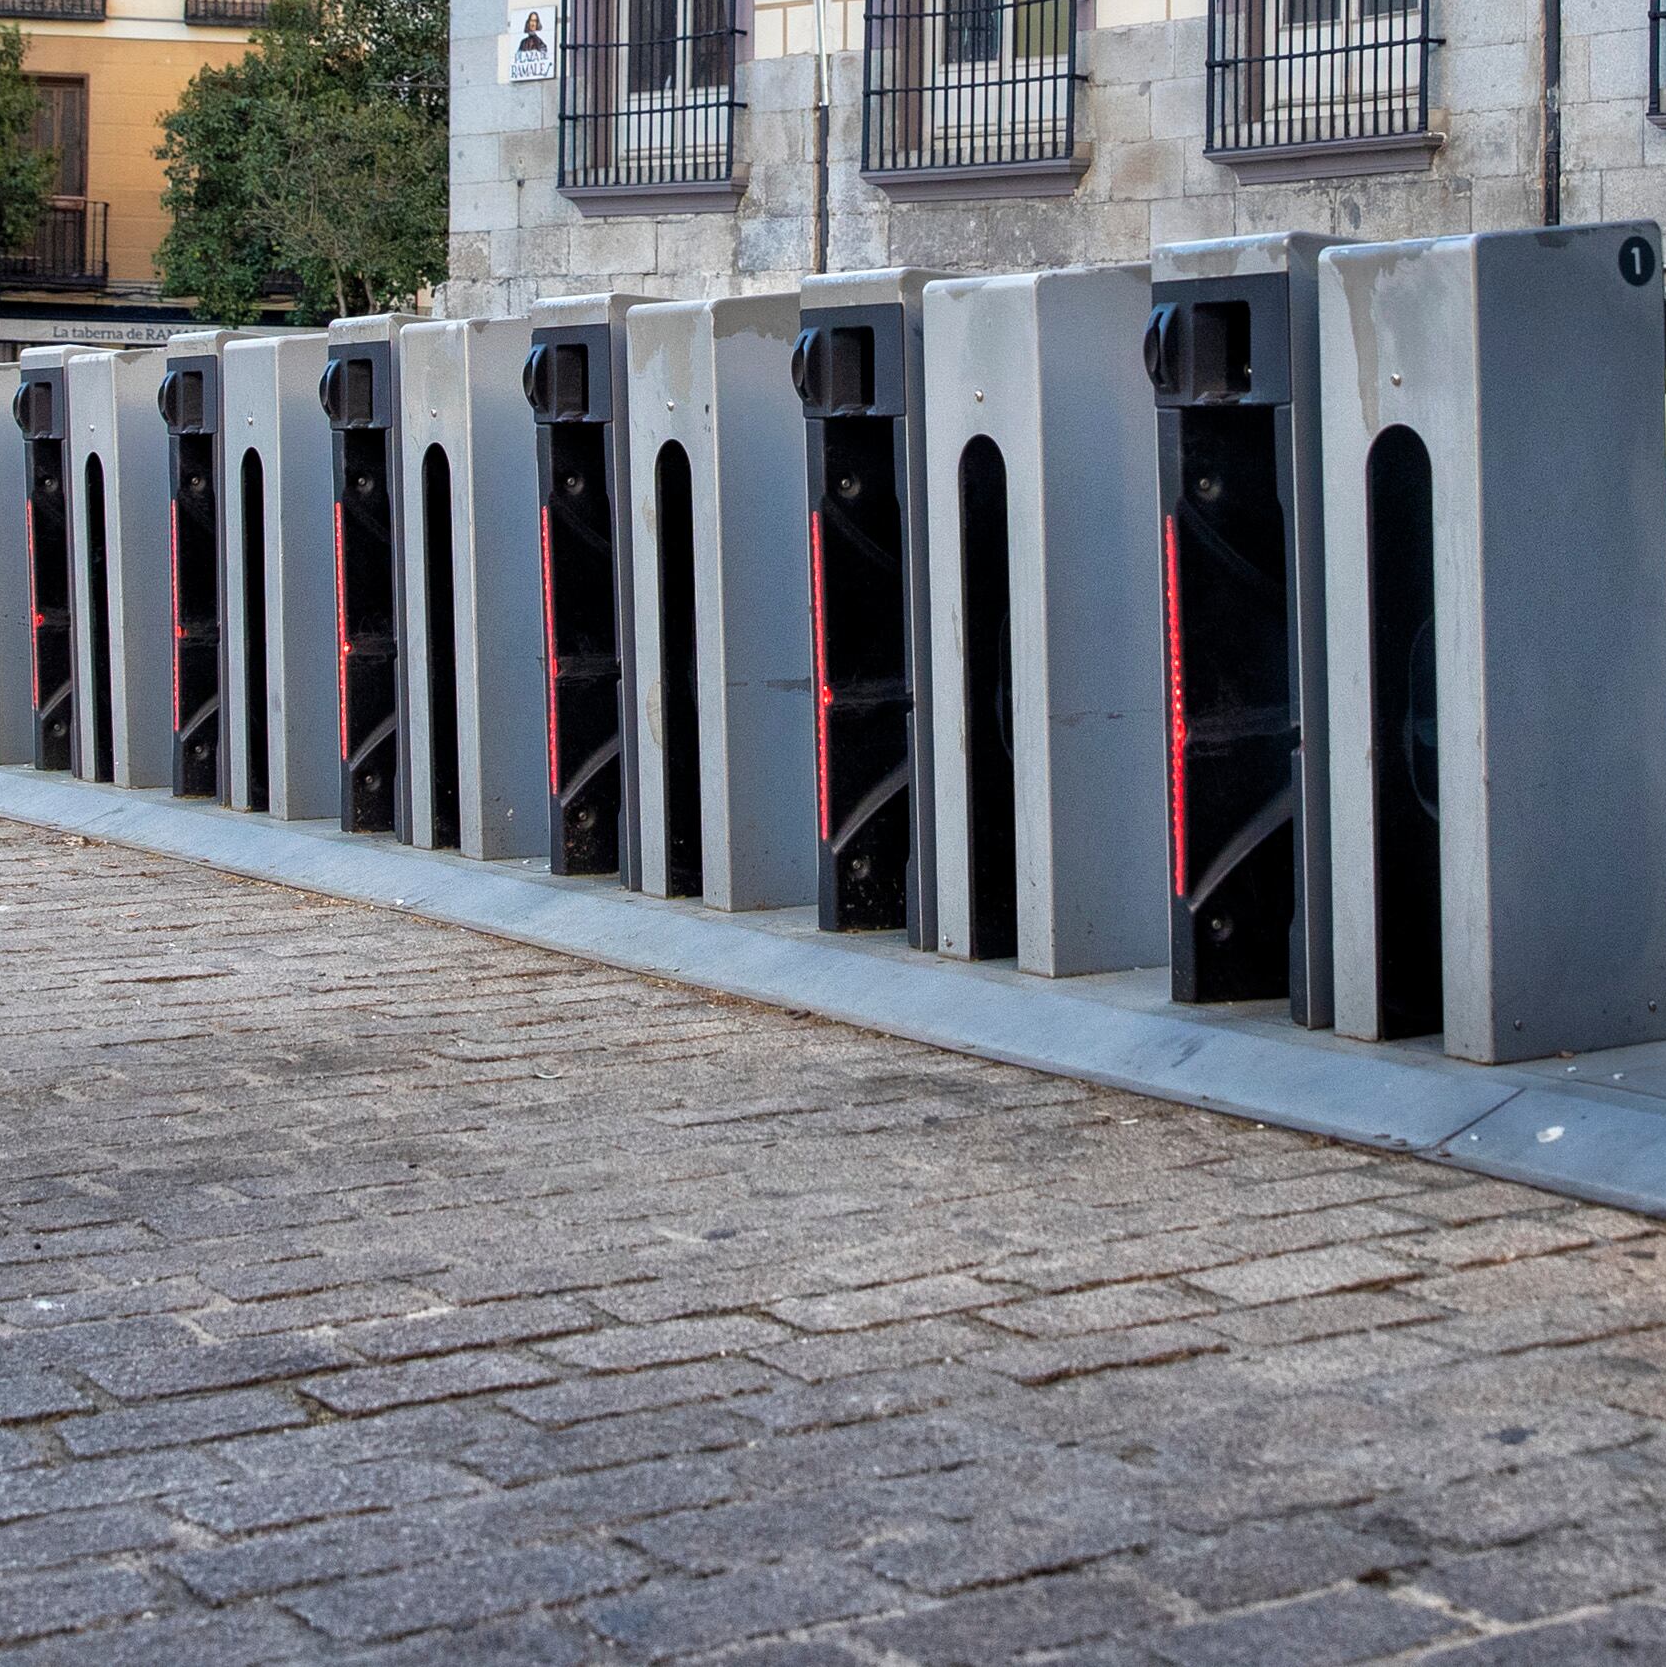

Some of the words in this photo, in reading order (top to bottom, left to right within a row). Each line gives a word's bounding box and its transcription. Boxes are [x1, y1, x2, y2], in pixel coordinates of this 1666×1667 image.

[1631, 246, 1642, 275] 1
[52, 326, 70, 339] La
[72, 327, 123, 340] taberna
[126, 329, 143, 341] de
